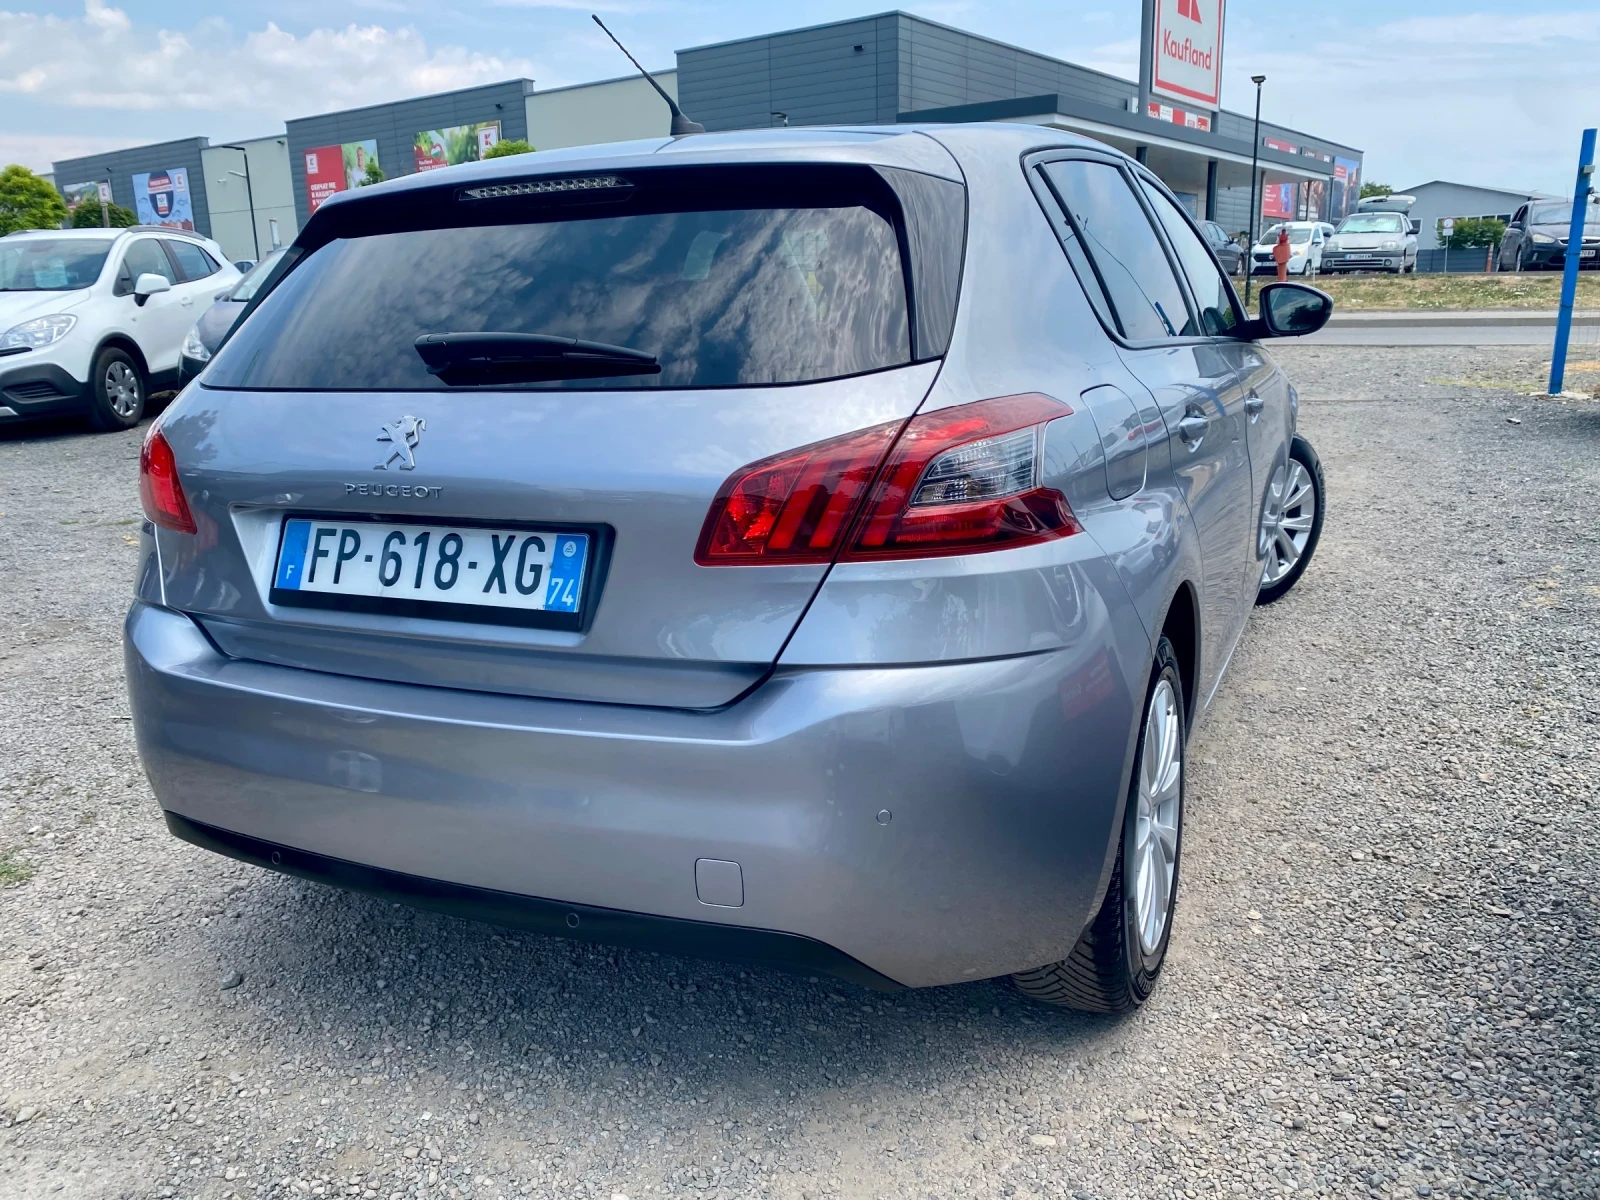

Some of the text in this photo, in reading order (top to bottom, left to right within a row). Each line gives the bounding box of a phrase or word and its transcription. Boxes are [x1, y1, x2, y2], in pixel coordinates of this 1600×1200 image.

[1163, 28, 1212, 71] Kaufland
[343, 482, 443, 499] PEUGEOT
[285, 564, 296, 580] F
[307, 528, 546, 596] FP-618-XG
[548, 577, 575, 607] 74
